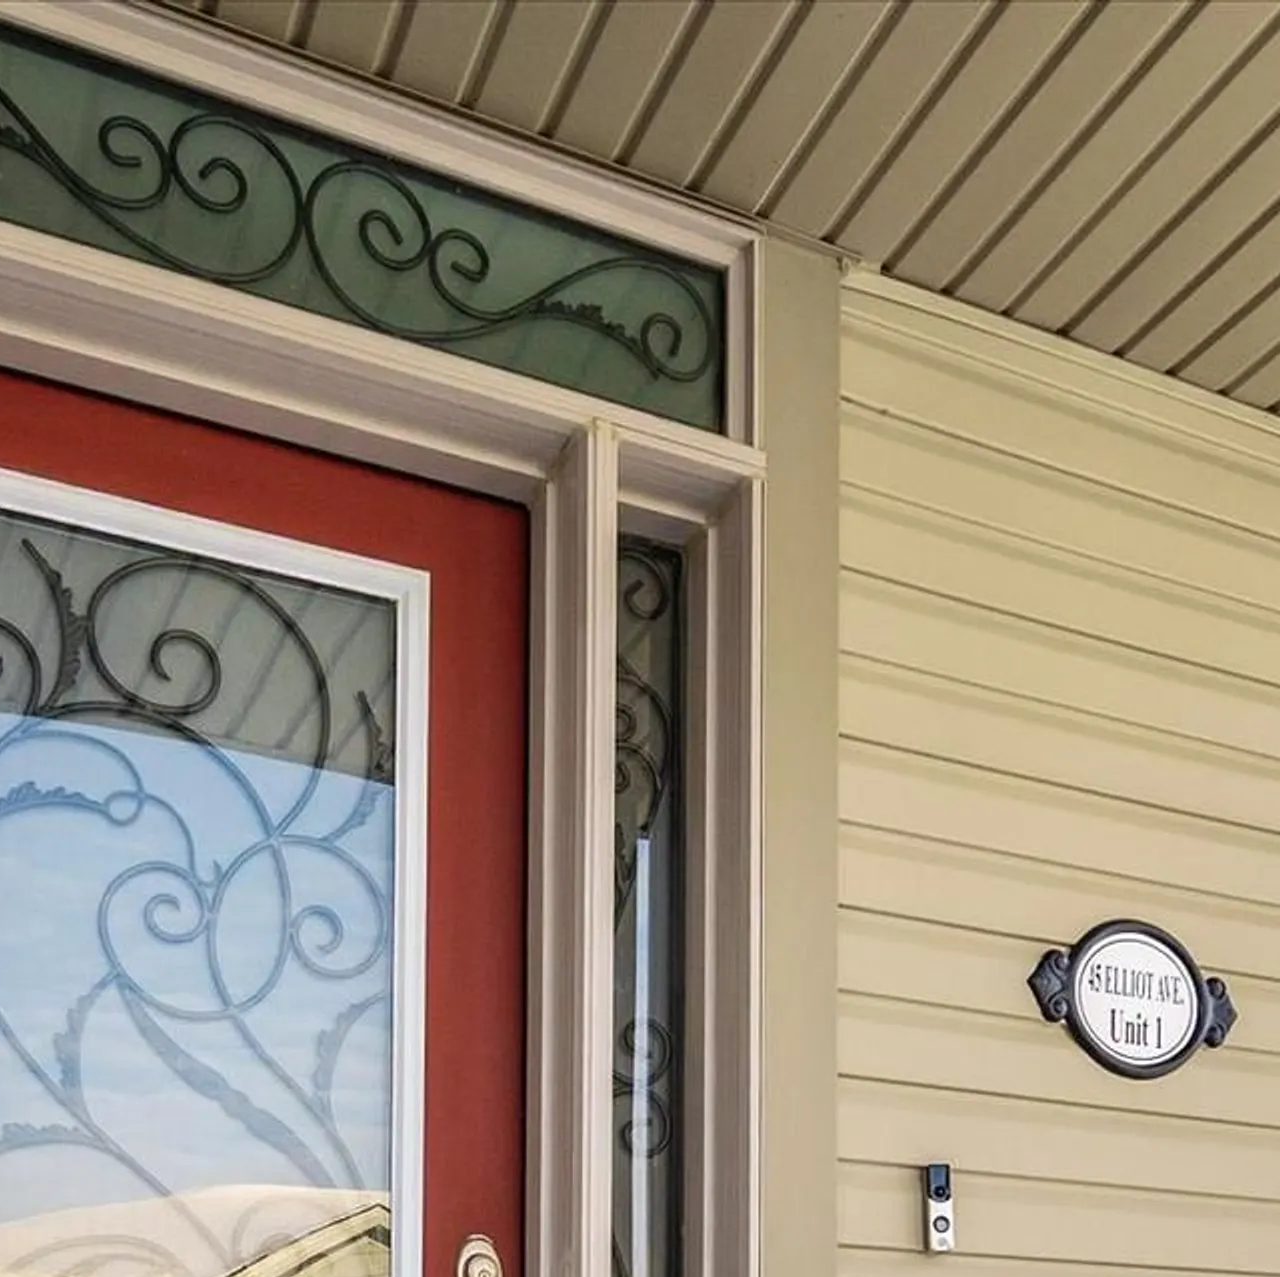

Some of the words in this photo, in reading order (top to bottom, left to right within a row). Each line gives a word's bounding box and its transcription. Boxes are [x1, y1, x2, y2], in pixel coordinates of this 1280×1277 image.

[1105, 966, 1153, 1000] ELLIOT
[1110, 1008, 1149, 1047] Unit
[1156, 1016, 1163, 1049] 1
